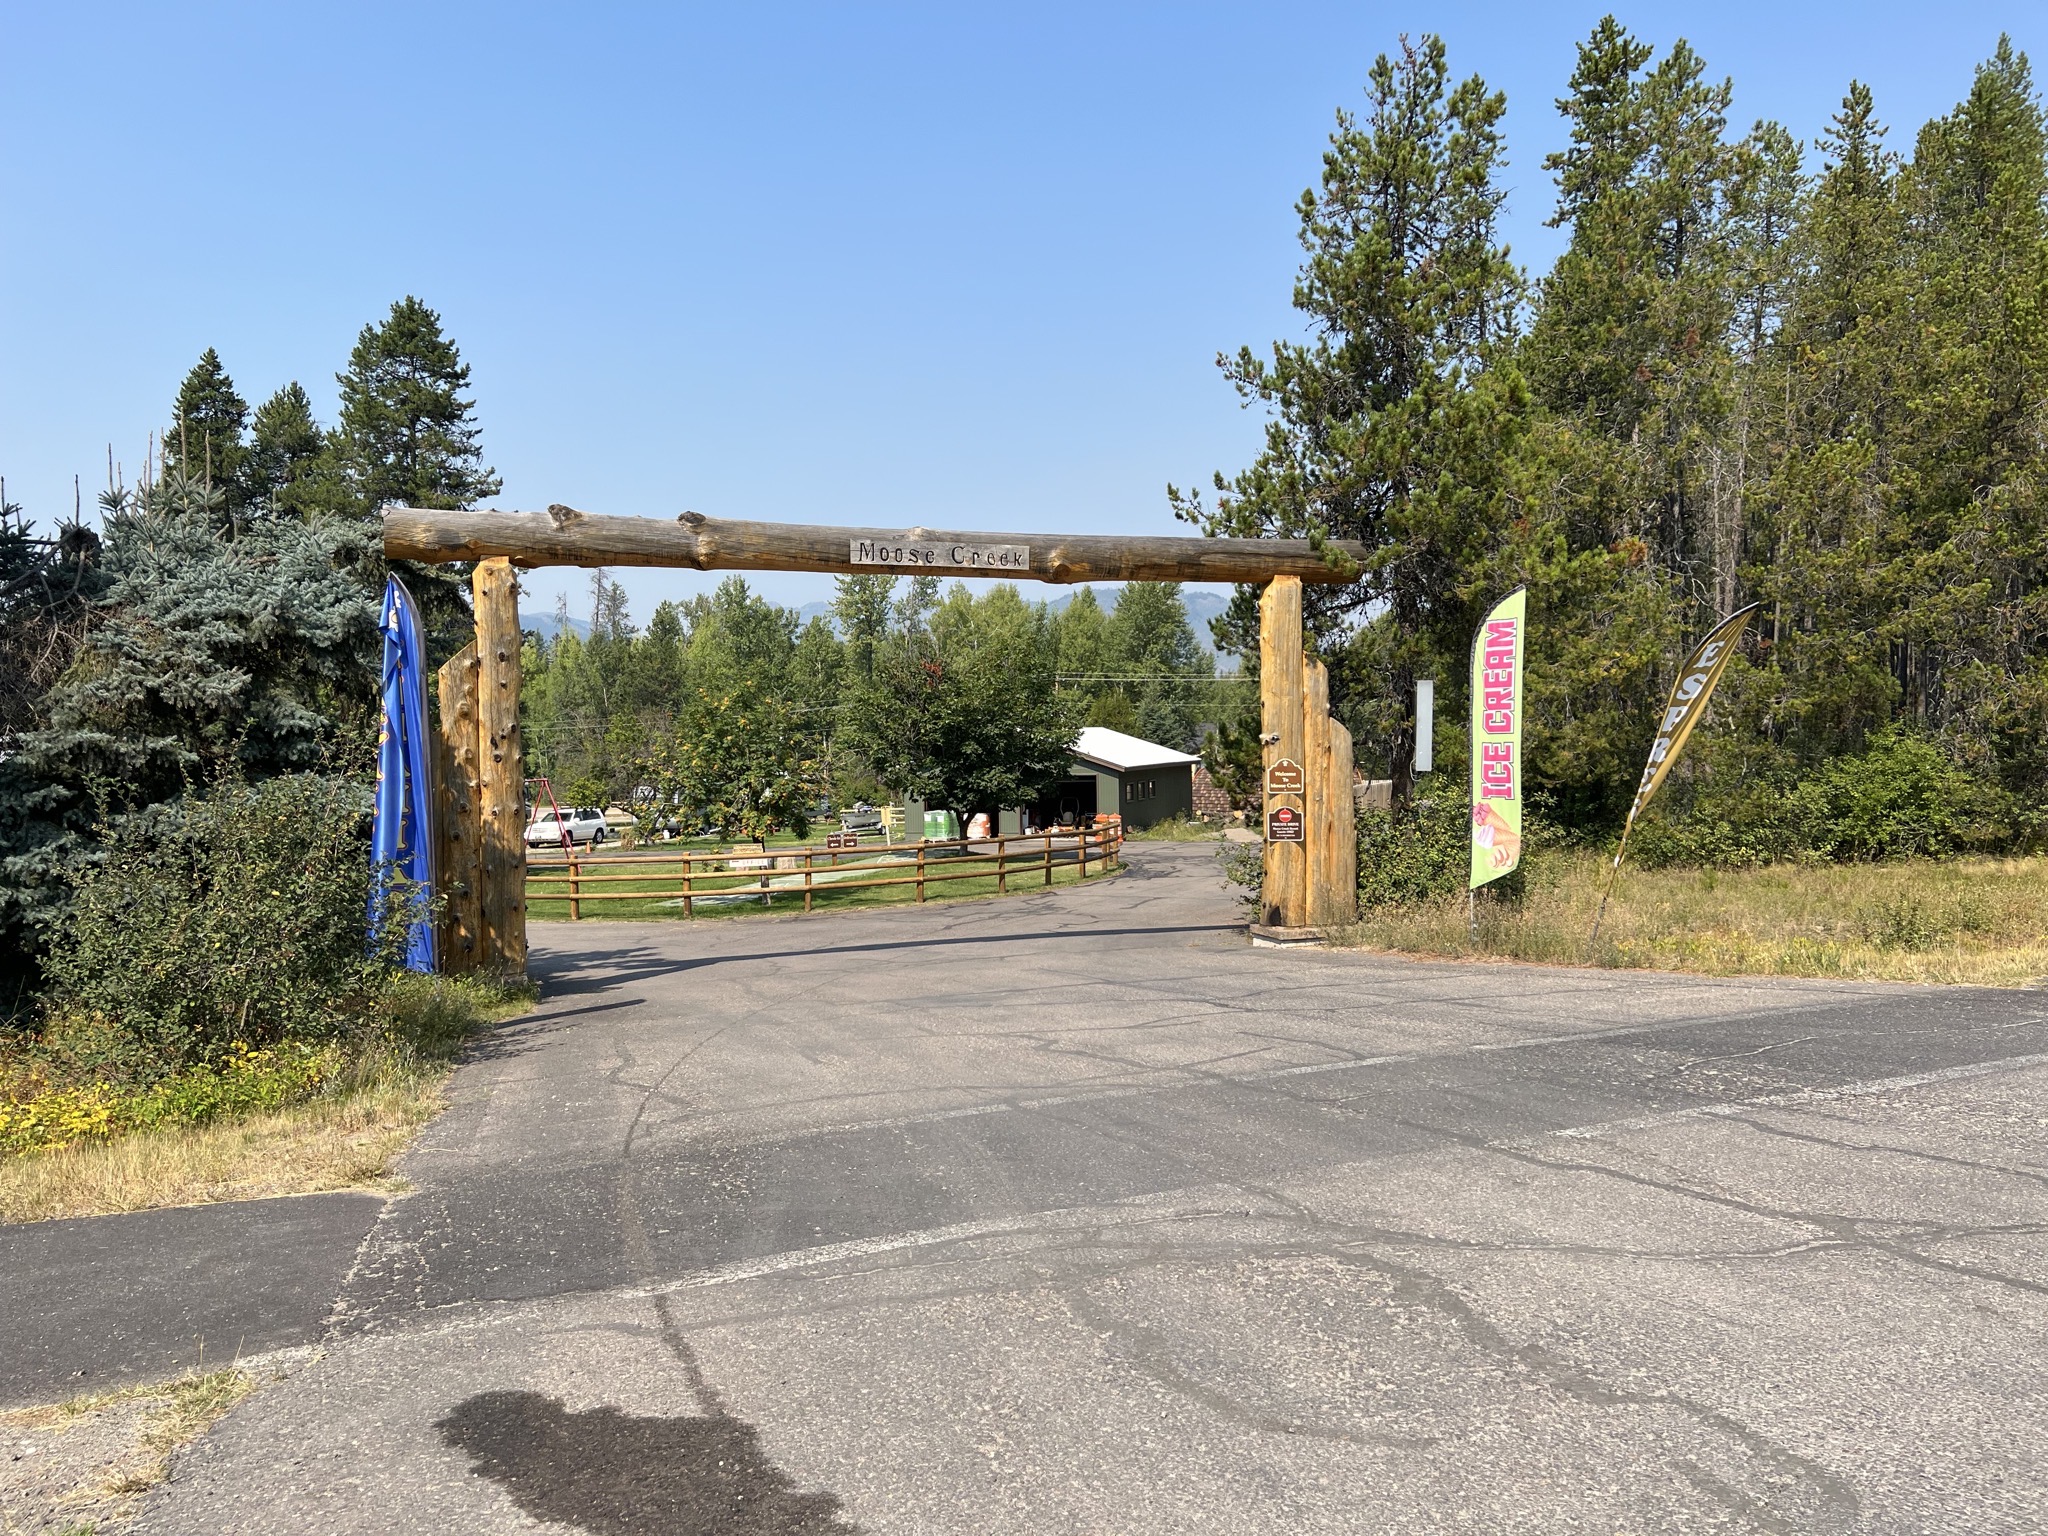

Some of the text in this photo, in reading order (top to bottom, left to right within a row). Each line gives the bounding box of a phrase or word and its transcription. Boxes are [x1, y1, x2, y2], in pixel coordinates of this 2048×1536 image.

[858, 542, 1023, 567] Moose Creek
[1481, 617, 1518, 801] ICE CREAM
